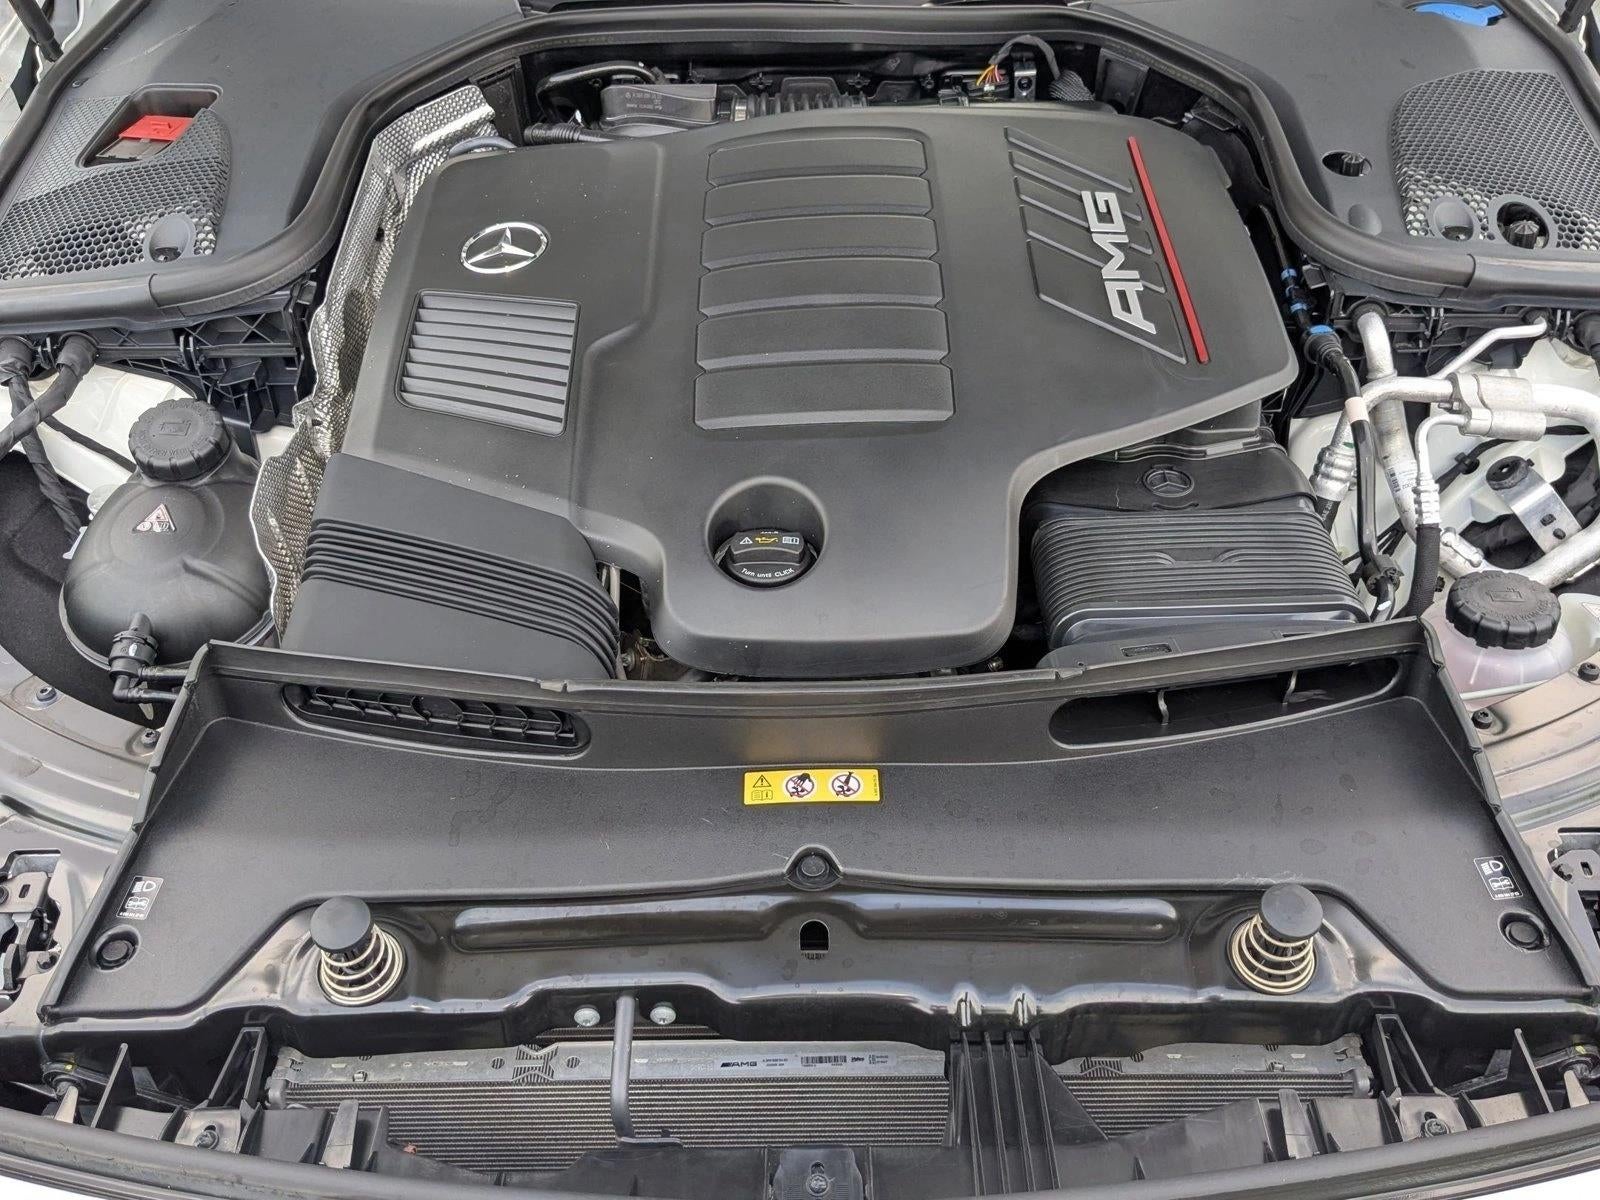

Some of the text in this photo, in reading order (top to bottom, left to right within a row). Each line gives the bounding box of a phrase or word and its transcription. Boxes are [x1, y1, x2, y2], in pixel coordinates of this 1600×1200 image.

[1081, 191, 1157, 335] AMG
[741, 567, 755, 577] Turn
[774, 567, 795, 578] CLICK
